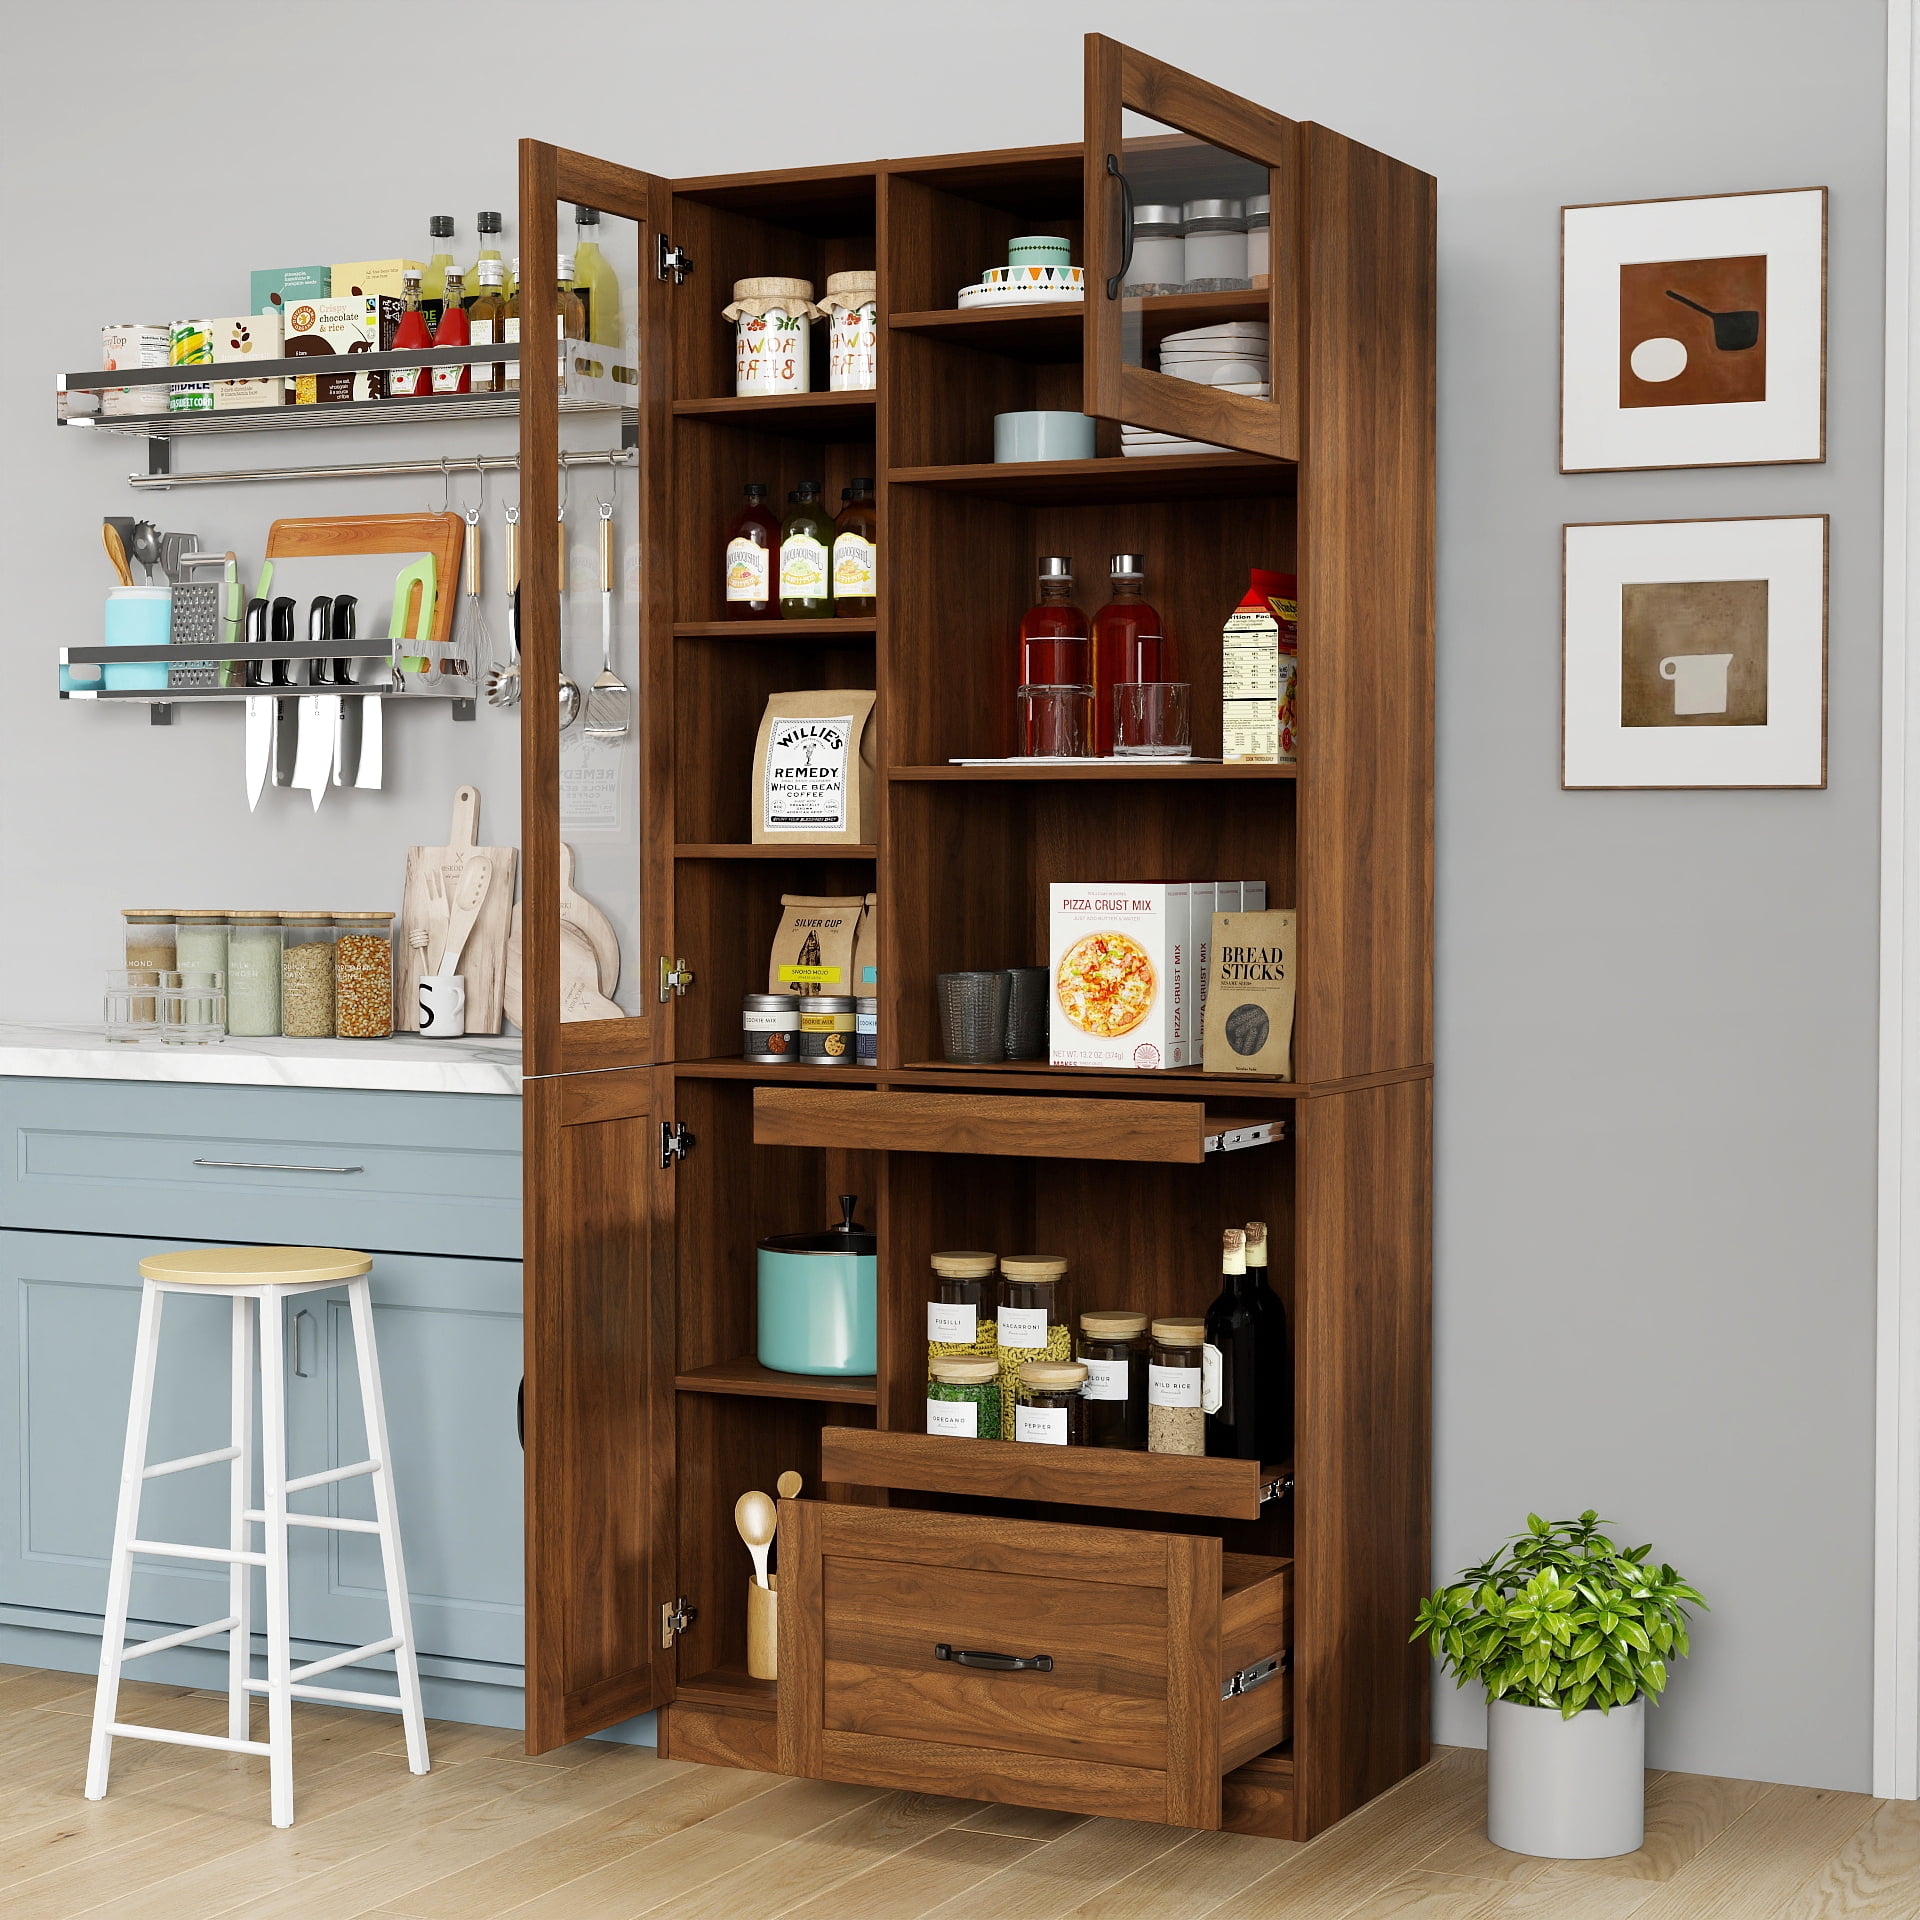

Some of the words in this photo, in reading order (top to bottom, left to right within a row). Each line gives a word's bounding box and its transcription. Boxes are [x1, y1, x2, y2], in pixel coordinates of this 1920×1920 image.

[319, 304, 347, 314] Crispy
[319, 313, 359, 323] chocolate
[319, 324, 327, 333] &
[328, 323, 345, 332] rice
[112, 335, 127, 347] Top
[175, 398, 193, 408] SWEET
[193, 397, 213, 407] CORN
[776, 725, 844, 750] WILLIE'S
[774, 767, 839, 778] REMEDY
[770, 783, 808, 792] WHOLE
[811, 781, 841, 791] BEAN
[1063, 899, 1092, 910] PIZZA
[1094, 899, 1129, 911] CRUST
[1132, 899, 1152, 911] MIX
[794, 918, 823, 928] SILVER
[824, 919, 843, 928] CUP
[1221, 946, 1283, 964] BREAD
[1221, 963, 1285, 981] STICKS
[1199, 965, 1207, 1003] CRUST
[419, 983, 435, 1029] S
[746, 1016, 764, 1024] COOKIE
[801, 1018, 821, 1026] COOKIE
[1053, 1050, 1065, 1058] NET
[932, 1415, 965, 1423] OREGANO
[1024, 1422, 1051, 1430] PEPPER
